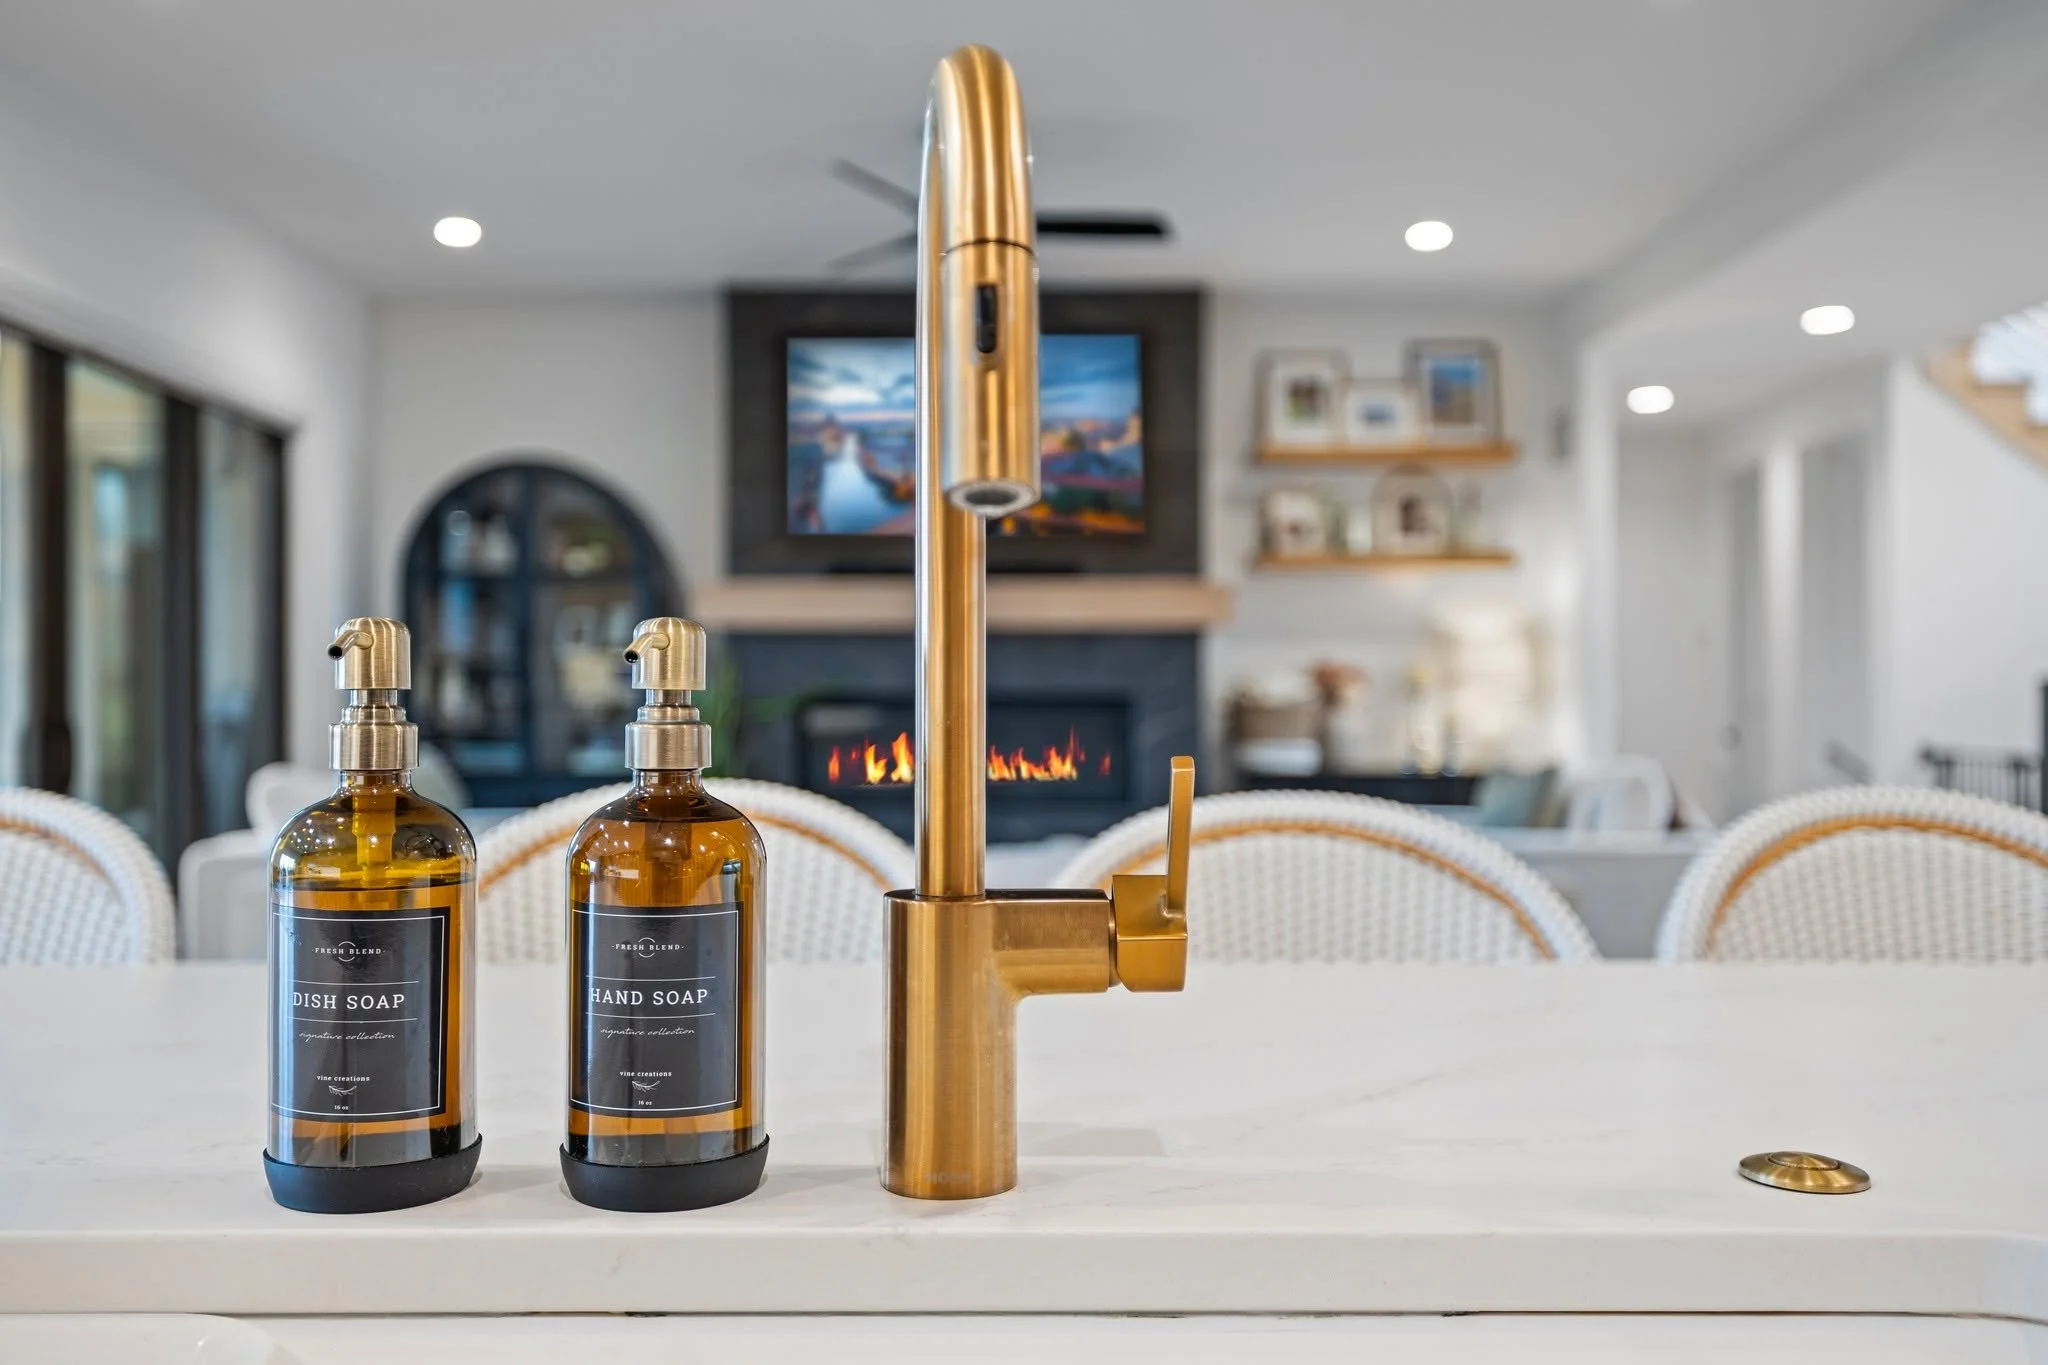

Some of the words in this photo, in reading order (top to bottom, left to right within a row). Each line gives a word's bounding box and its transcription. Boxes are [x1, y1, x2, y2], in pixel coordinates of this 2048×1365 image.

[349, 947, 382, 956] BLEND
[293, 991, 337, 1010] DISH
[346, 993, 405, 1010] SOAP
[590, 987, 643, 1006] HAND
[652, 988, 708, 1006] SOAP
[299, 1031, 343, 1043] signature
[345, 1032, 395, 1040] collection
[600, 1026, 646, 1039] signature
[647, 1027, 695, 1036] collection
